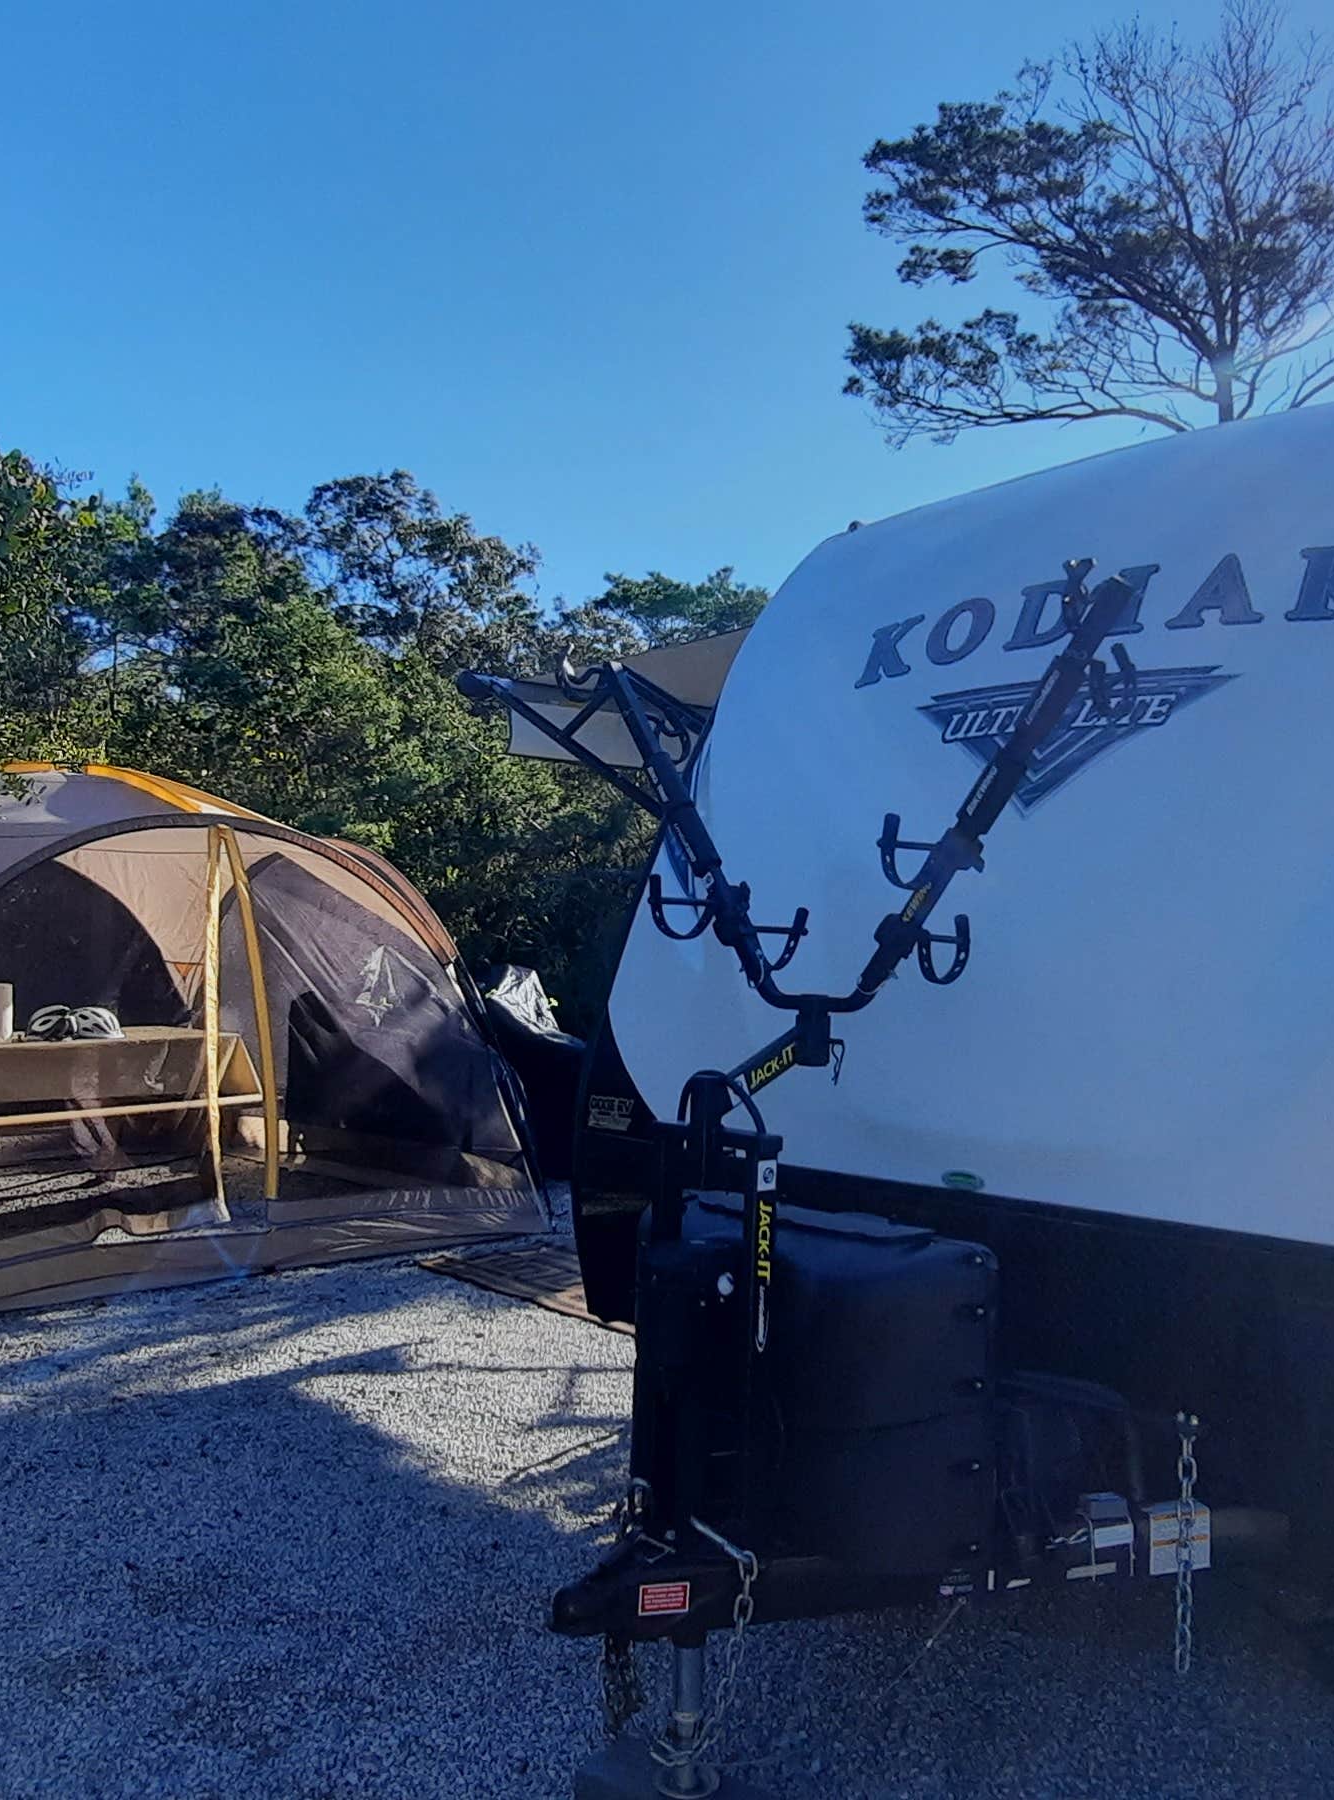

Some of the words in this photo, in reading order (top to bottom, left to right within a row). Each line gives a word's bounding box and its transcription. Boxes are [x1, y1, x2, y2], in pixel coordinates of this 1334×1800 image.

[944, 706, 1024, 741] ULT
[750, 1041, 796, 1089] JACK-IT
[757, 1200, 773, 1285] JACK-IT
